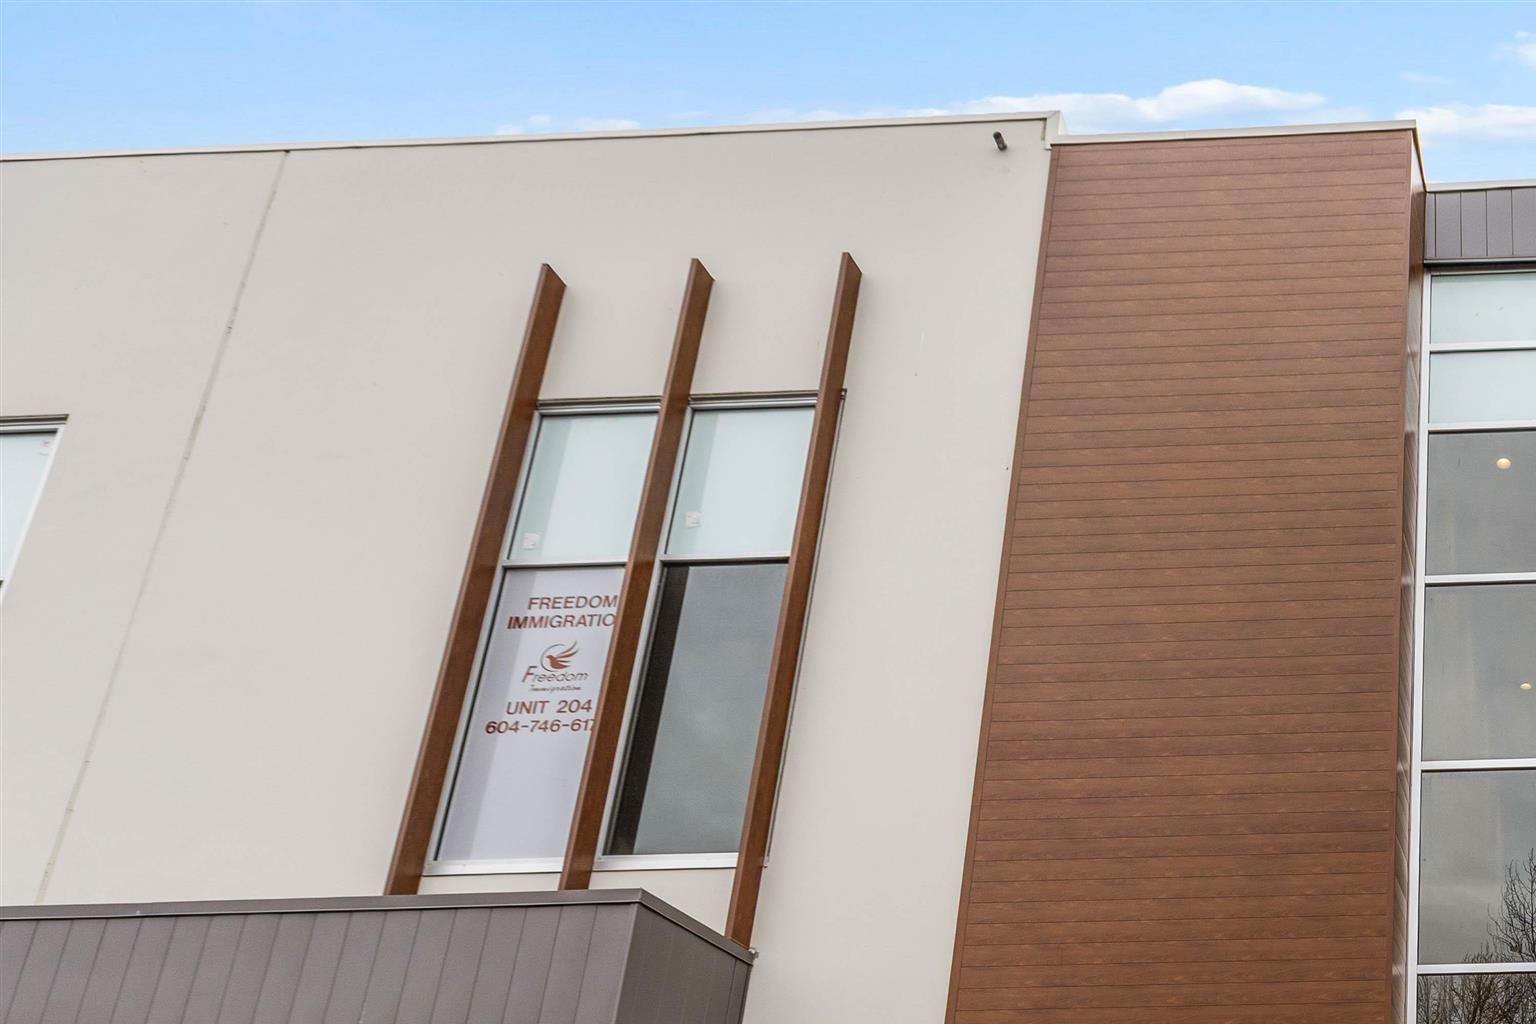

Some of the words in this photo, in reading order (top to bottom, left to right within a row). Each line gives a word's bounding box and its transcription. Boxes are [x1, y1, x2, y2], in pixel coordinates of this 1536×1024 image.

[527, 595, 618, 610] FREEDOM
[521, 665, 589, 683] Freedom
[506, 700, 550, 715] UNIT
[556, 699, 593, 714] 204
